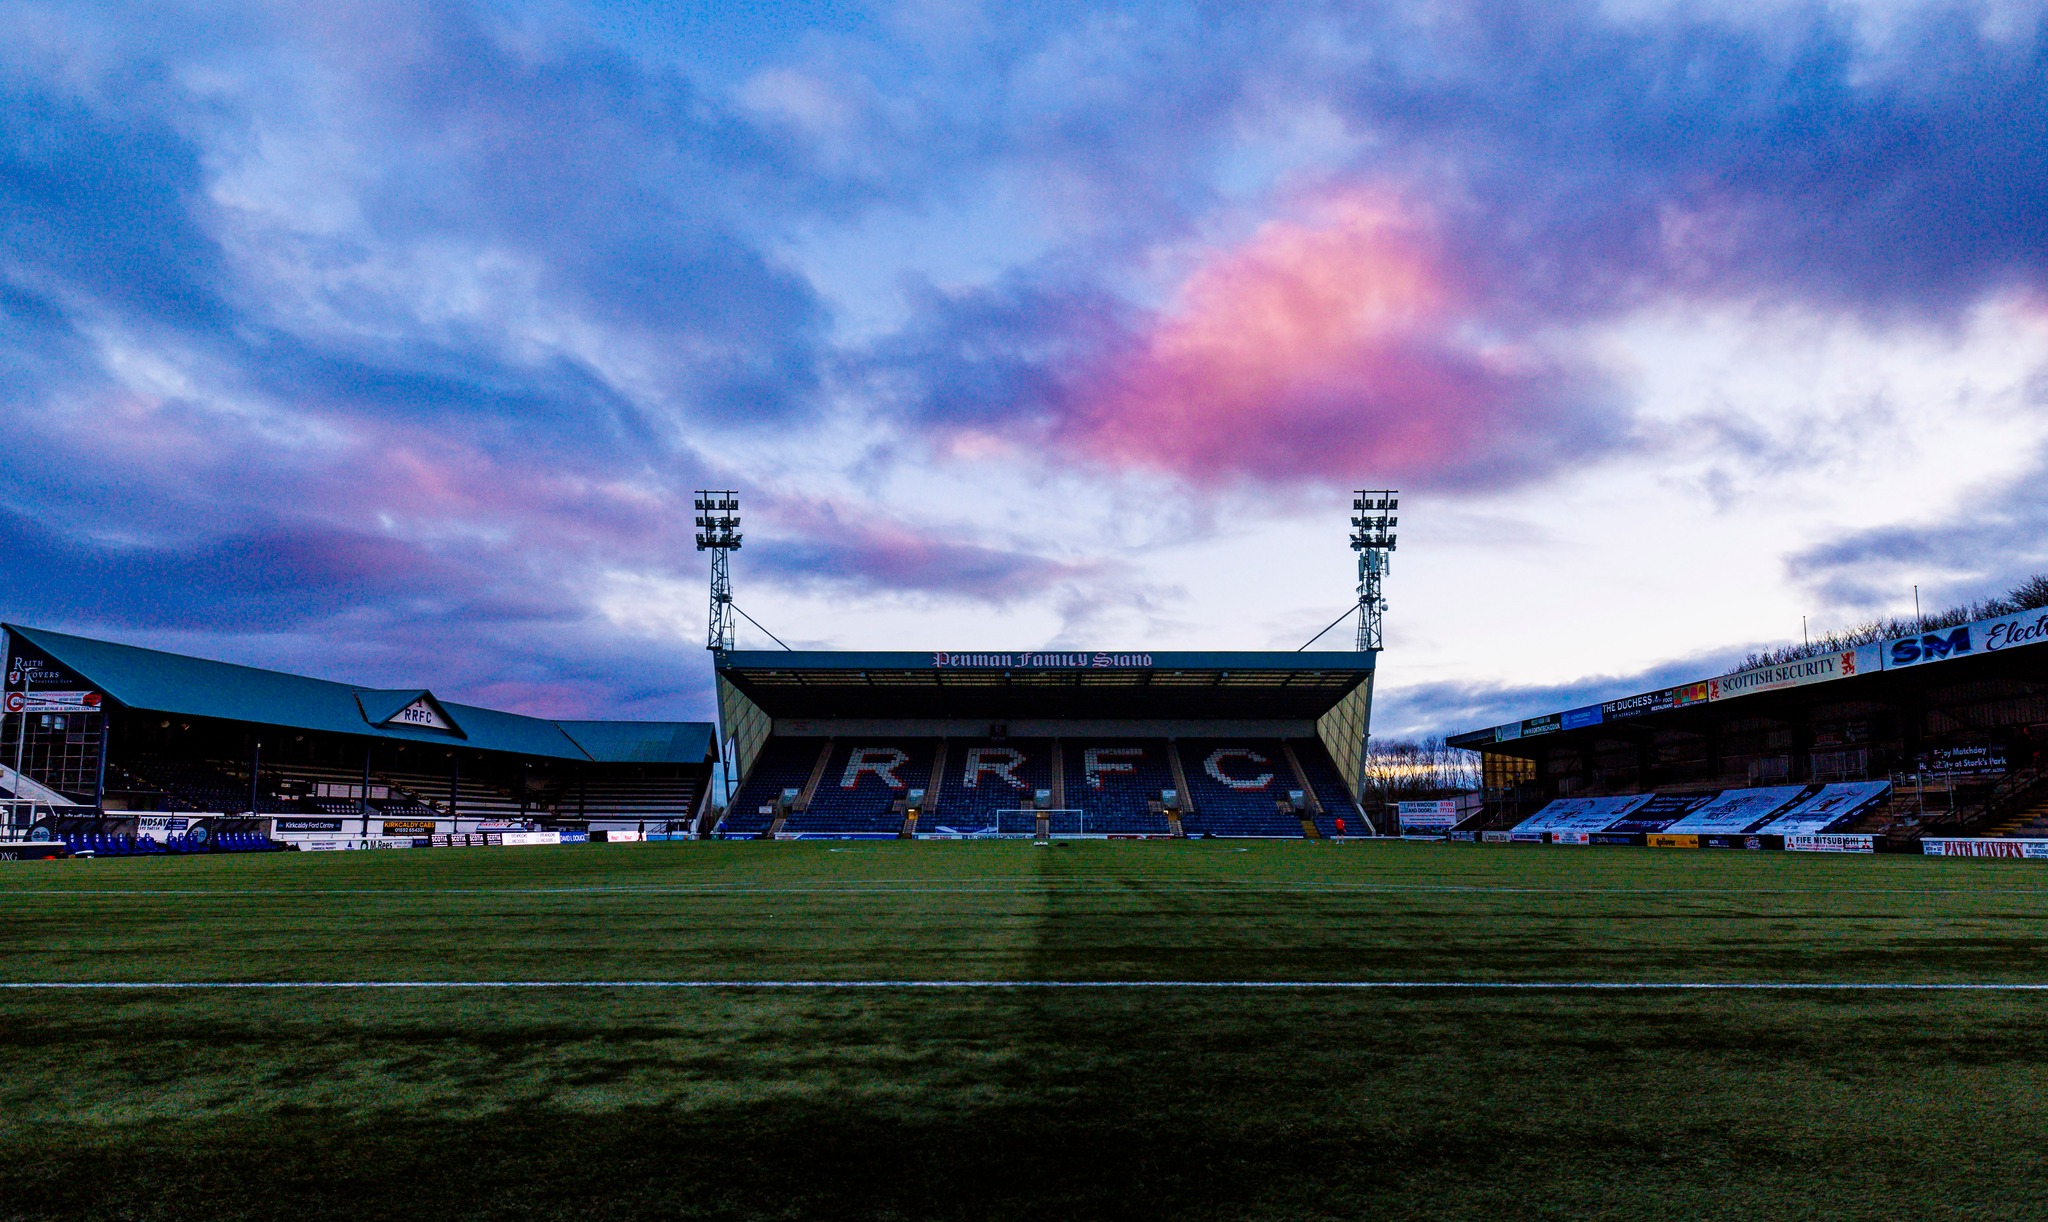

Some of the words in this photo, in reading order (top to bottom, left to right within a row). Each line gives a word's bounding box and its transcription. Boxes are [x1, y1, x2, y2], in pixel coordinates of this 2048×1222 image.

[1891, 626, 1972, 665] SM
[1985, 614, 2048, 651] Elect
[14, 657, 43, 672] RAITH
[932, 652, 1012, 668] Penman
[1014, 652, 1088, 669] Family
[1091, 652, 1152, 668] Stand
[23, 667, 60, 683] ROVERS
[1723, 672, 1773, 692] SCOTTISH
[1775, 658, 1835, 682] SECURITY
[1602, 704, 1616, 713] THE
[1617, 696, 1653, 711] DUCHESS
[404, 709, 432, 724] RRFC
[1952, 746, 1987, 756] Matchday
[1955, 760, 1962, 768] at
[1963, 758, 1988, 768] Stark's
[285, 821, 308, 830] Kirkcaldy
[319, 821, 335, 829] Centre
[1813, 837, 1859, 845] MITSUBISHI
[1944, 841, 1973, 856] PATH
[1974, 841, 2024, 858] TAVERN
